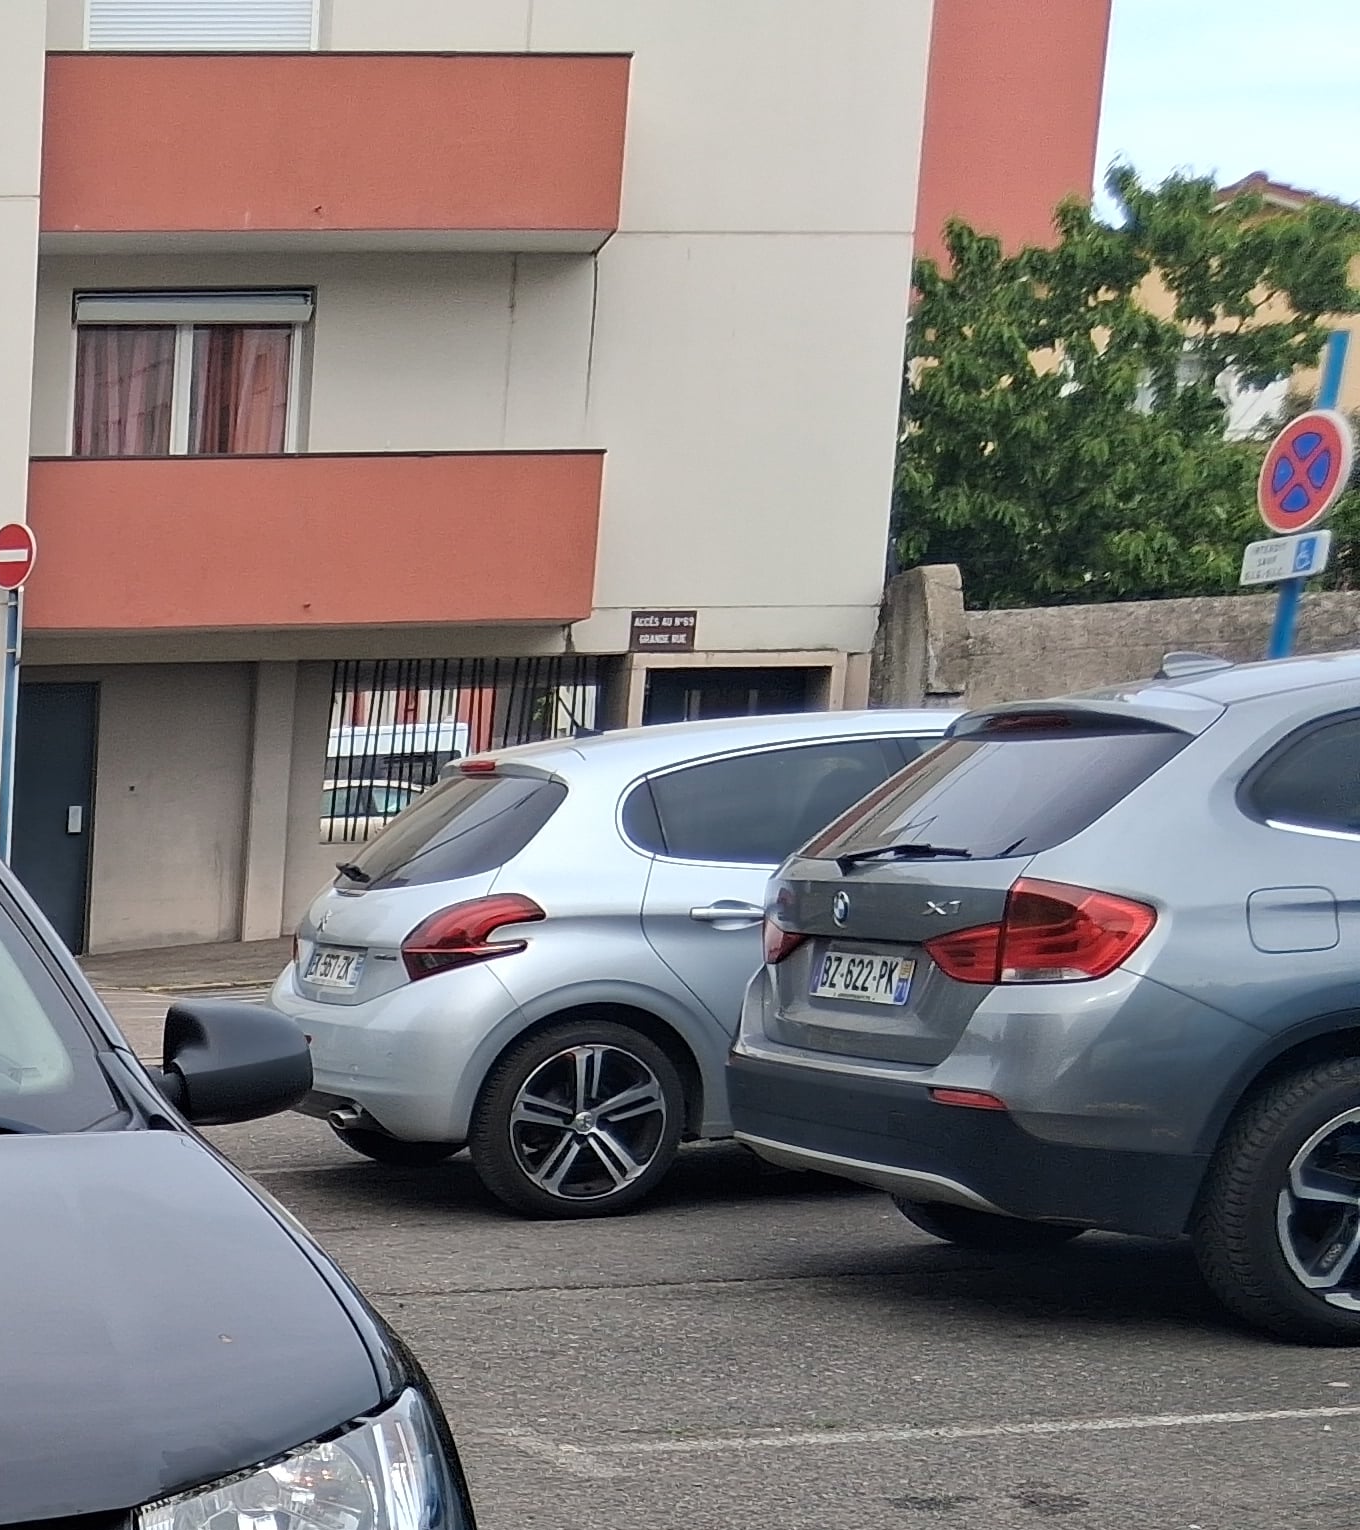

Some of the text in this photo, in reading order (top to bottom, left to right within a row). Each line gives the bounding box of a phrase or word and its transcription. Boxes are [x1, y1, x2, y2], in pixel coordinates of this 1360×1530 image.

[661, 617, 673, 627] AU
[671, 634, 687, 644] RUE
[921, 900, 961, 916] X1
